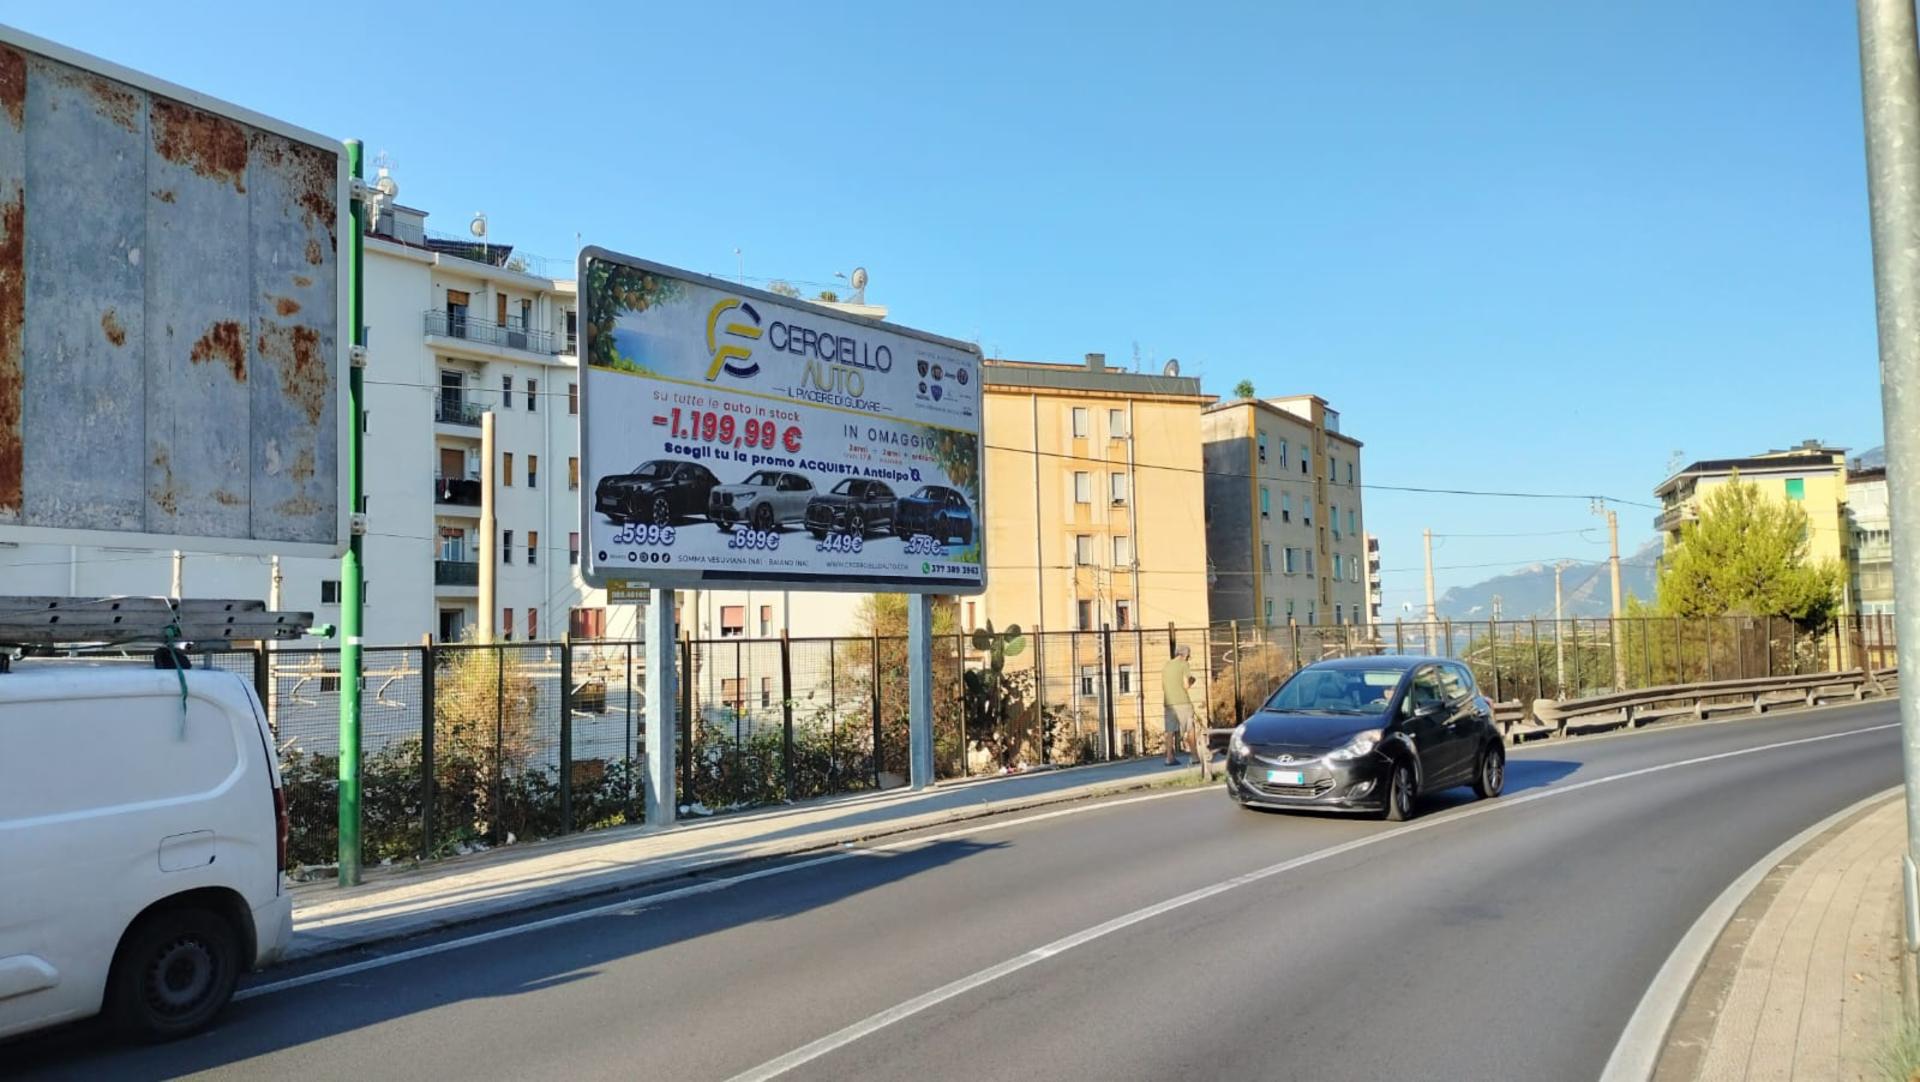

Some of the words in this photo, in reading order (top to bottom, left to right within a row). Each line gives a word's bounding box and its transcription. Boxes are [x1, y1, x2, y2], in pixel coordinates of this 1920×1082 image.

[769, 321, 892, 373] CERCIELLO
[801, 359, 865, 398] AUTO
[673, 391, 704, 406] tutte
[723, 402, 752, 414] auto
[755, 405, 766, 416] in
[770, 408, 800, 422] stock
[783, 425, 803, 453] €
[844, 424, 858, 439] IN
[868, 427, 935, 450] OMAGGIO
[665, 442, 711, 459] Scegli
[714, 448, 730, 460] tu
[734, 450, 747, 462] la
[752, 453, 795, 468] promo
[799, 458, 859, 476] ACQUISTA
[863, 468, 909, 483] Anticipo
[622, 523, 676, 546] 599€
[736, 529, 780, 550] 699€
[823, 535, 863, 553] 449€
